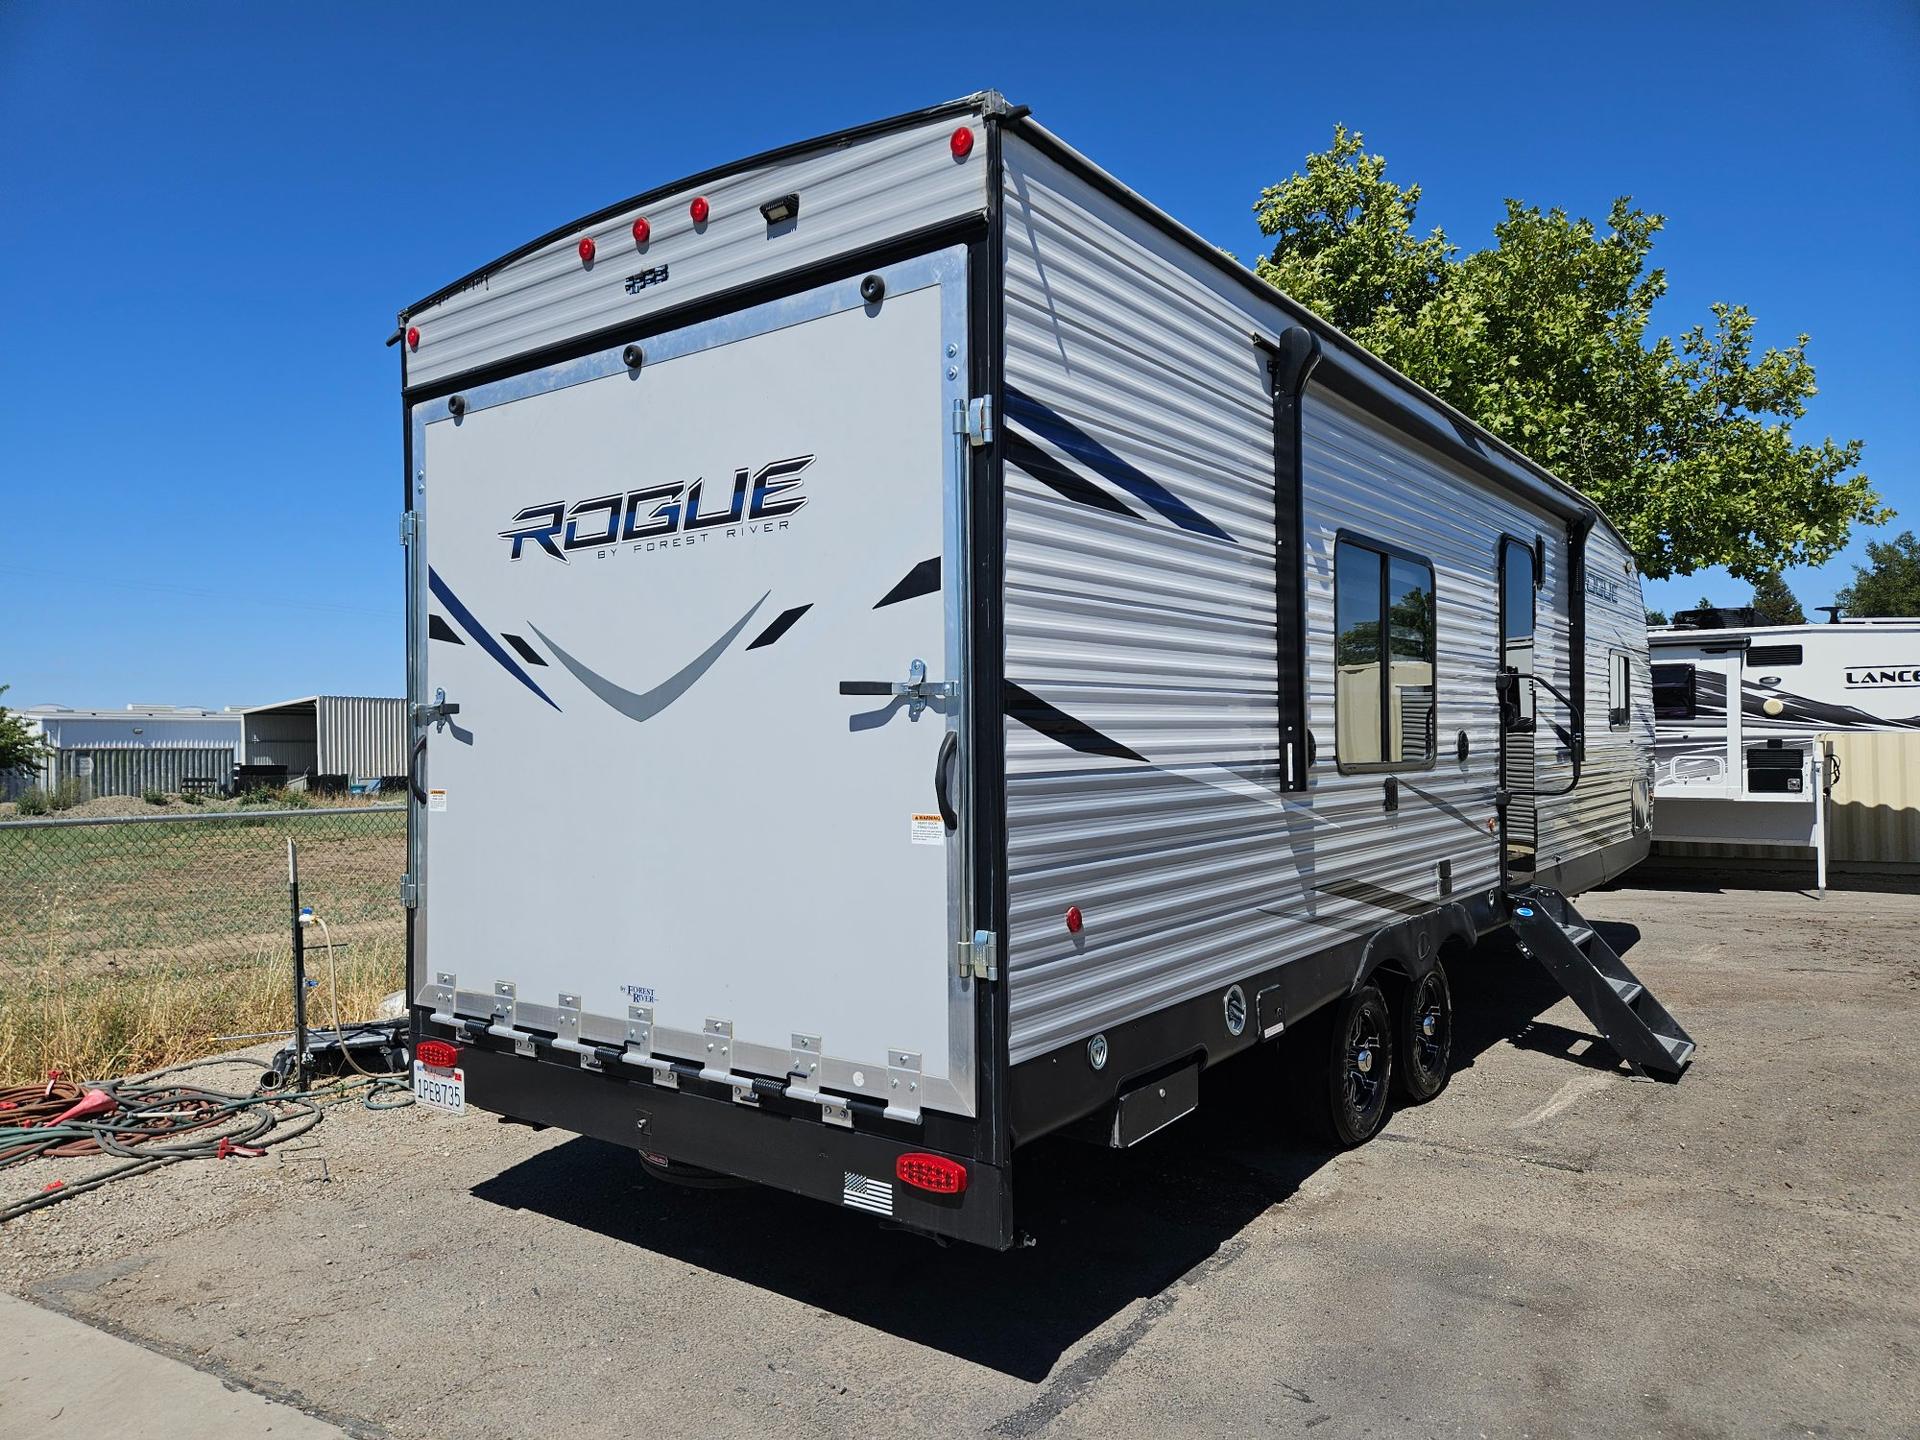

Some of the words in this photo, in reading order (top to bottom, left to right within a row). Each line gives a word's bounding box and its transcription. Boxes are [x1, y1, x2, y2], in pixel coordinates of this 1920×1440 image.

[498, 454, 816, 565] ROGUE
[597, 548, 617, 560] BY
[633, 533, 709, 553] FOREST
[726, 520, 789, 538] RIVER
[1585, 572, 1618, 604] OGUE
[418, 1078, 461, 1107] 1PE8735
